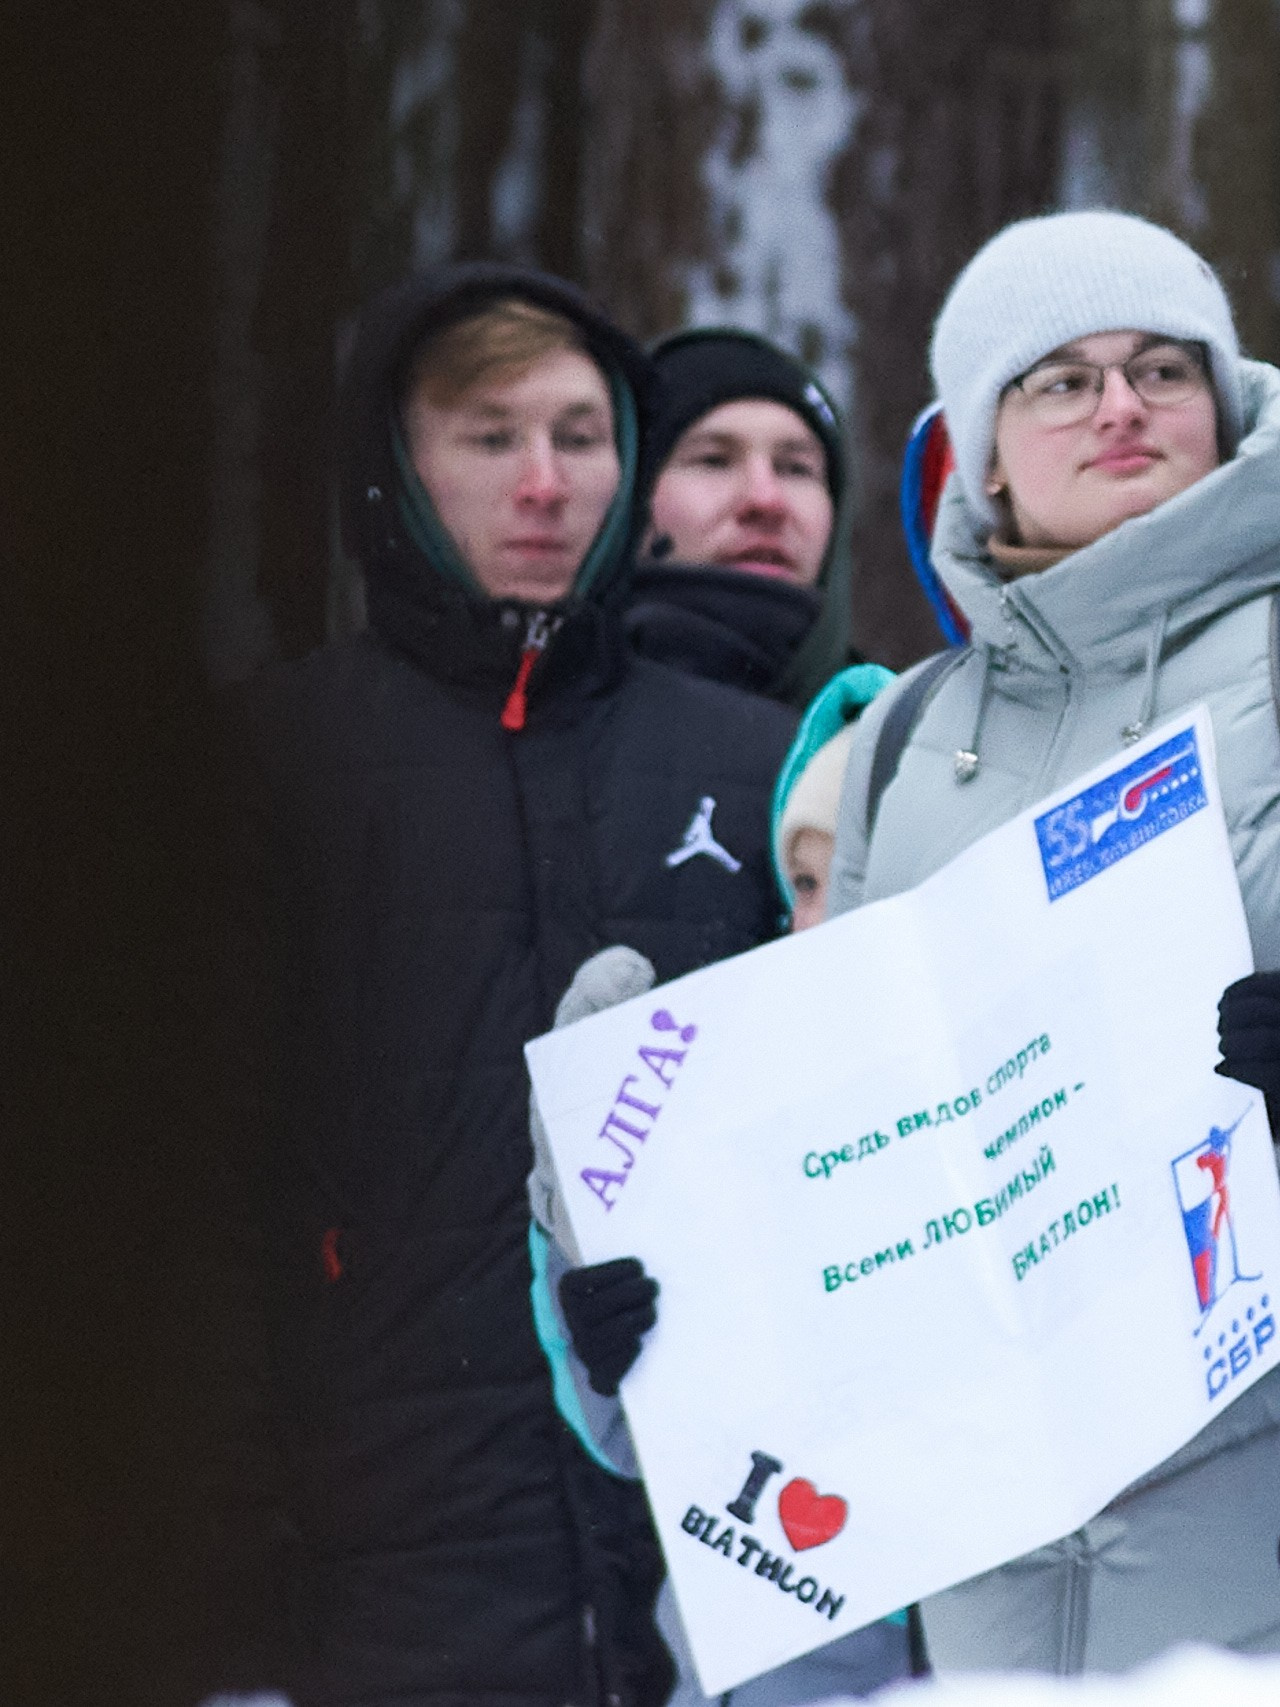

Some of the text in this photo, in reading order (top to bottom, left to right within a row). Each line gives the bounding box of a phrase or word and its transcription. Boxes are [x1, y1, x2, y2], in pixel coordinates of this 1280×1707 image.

[580, 1008, 697, 1212] АЛГА!
[802, 1032, 1052, 1179] Средь видов спорта
[984, 1087, 1068, 1160] чемпион
[822, 1142, 1057, 1293] Всеми ЛЮБИМЫЙ
[1011, 1182, 1122, 1282] БИАТЛОН!
[1207, 1313, 1276, 1402] СБР
[726, 1449, 784, 1525] I
[681, 1503, 846, 1621] BIATHLON
